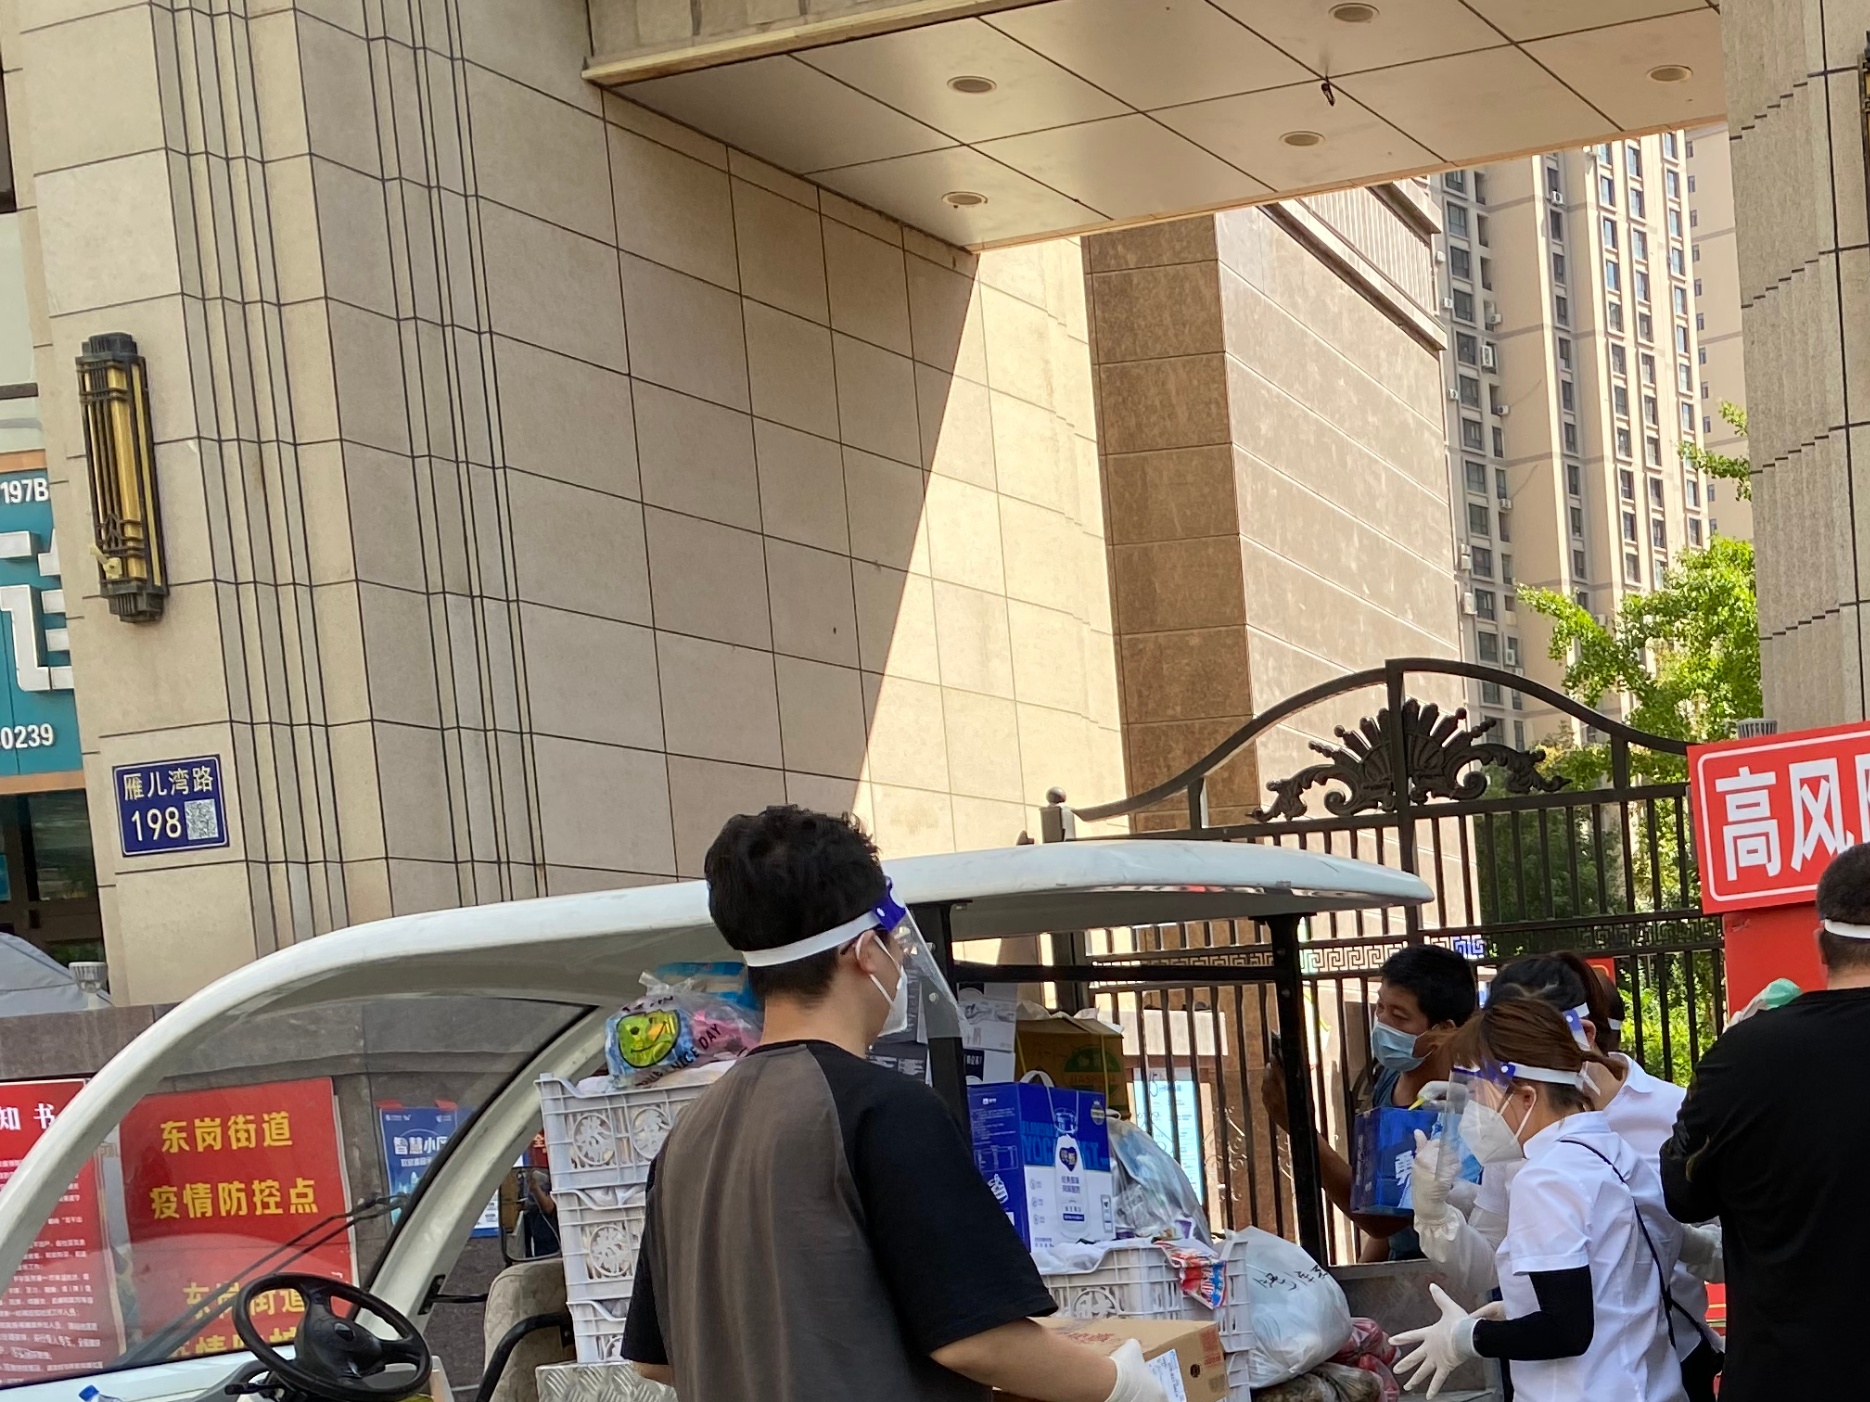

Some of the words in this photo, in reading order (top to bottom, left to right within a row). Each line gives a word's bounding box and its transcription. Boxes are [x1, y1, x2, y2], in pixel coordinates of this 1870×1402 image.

[123, 765, 215, 801] 雁儿湾路
[131, 808, 182, 842] 198
[698, 1024, 722, 1051] DAY
[160, 1111, 293, 1153] 东岗街道
[150, 1177, 319, 1220] 疫情防控点
